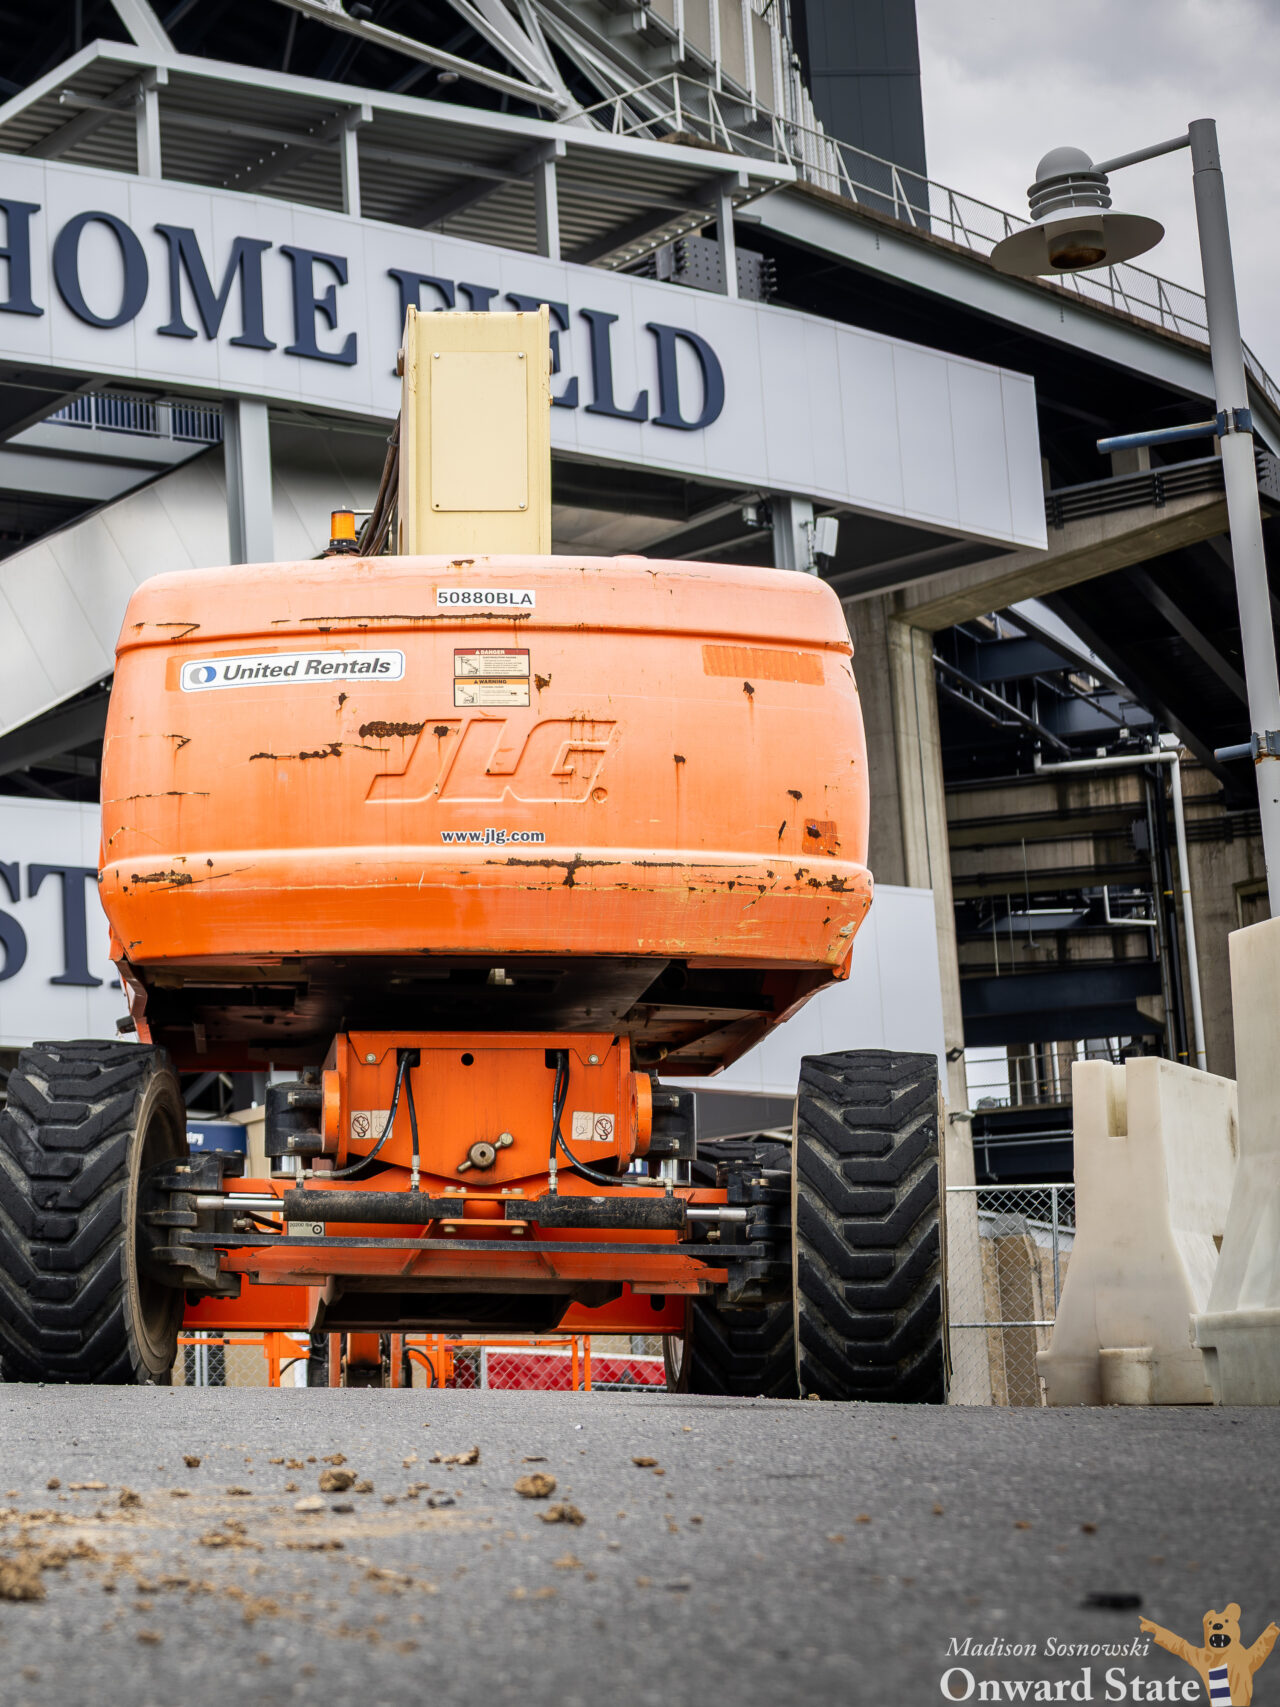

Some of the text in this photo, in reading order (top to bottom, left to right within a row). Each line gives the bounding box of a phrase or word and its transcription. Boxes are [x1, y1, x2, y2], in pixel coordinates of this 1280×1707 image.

[438, 591, 533, 606] 50880BLA
[223, 657, 391, 681] United Rentals
[364, 718, 617, 803] JLG
[441, 829, 546, 845] www.jlg.com
